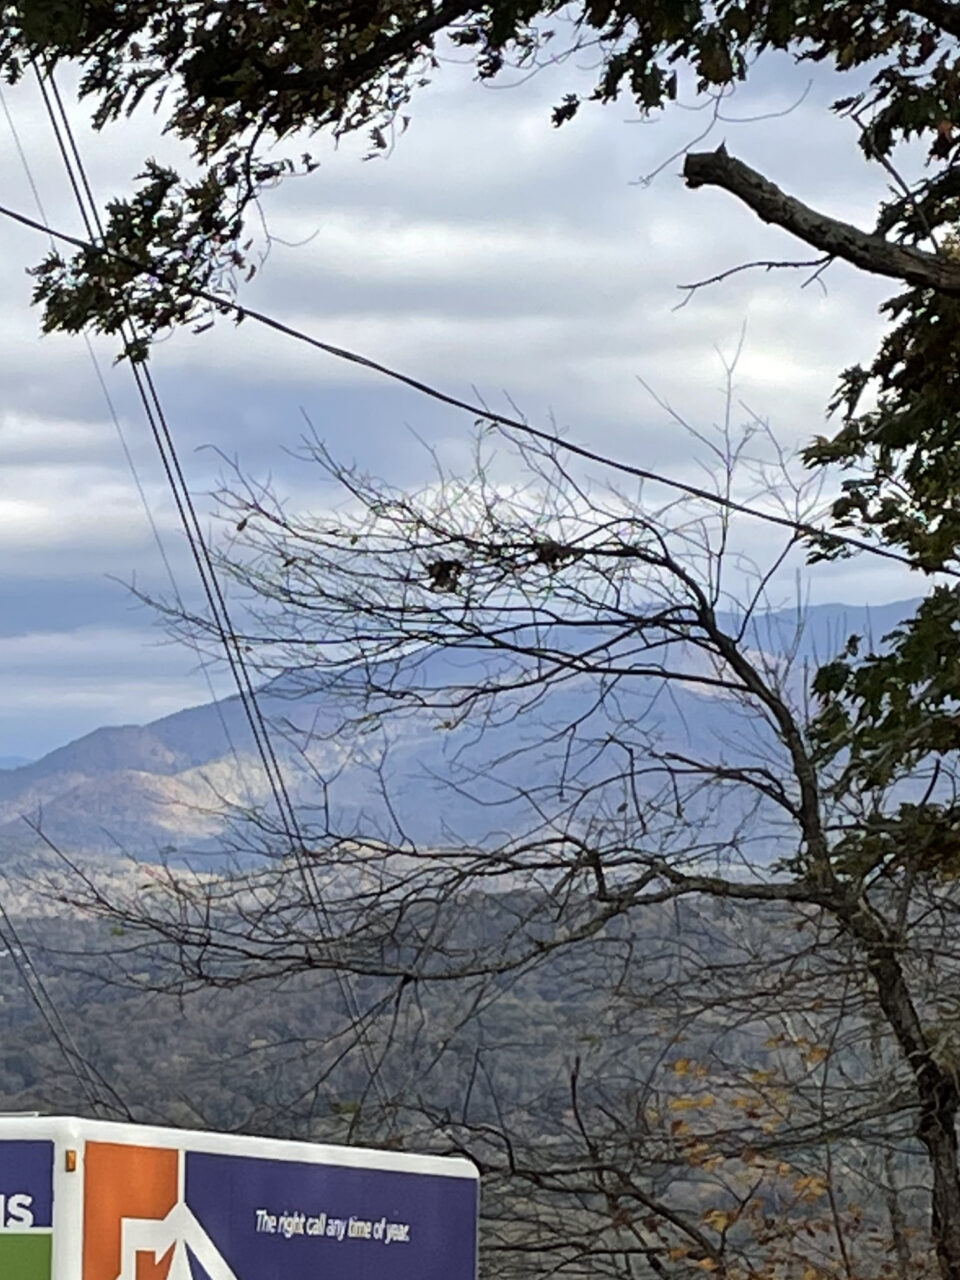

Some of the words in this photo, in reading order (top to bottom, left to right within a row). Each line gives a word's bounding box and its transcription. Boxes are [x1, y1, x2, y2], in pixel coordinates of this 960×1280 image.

[256, 1209, 277, 1233] The
[278, 1210, 306, 1238] right
[306, 1213, 327, 1236] call
[326, 1218, 347, 1241] any
[347, 1216, 372, 1239] time
[373, 1217, 387, 1240] of
